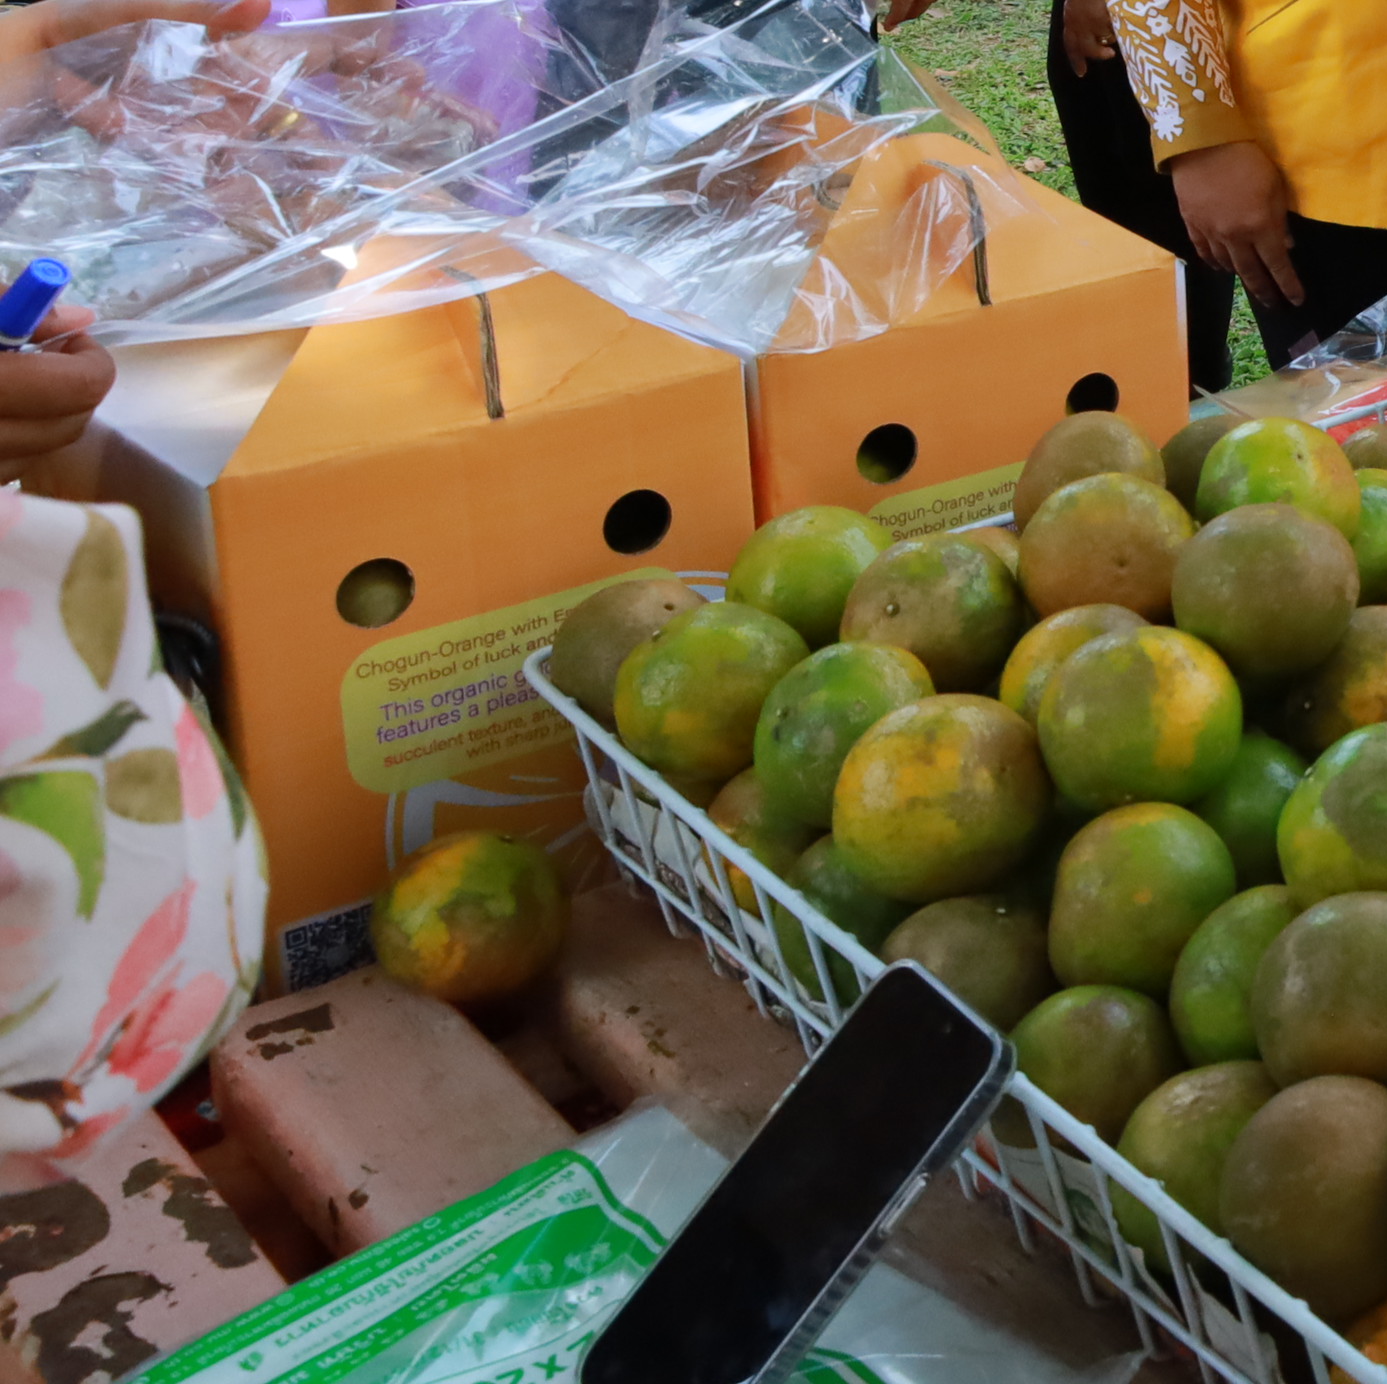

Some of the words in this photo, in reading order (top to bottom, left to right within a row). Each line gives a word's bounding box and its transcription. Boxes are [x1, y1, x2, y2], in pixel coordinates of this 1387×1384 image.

[949, 513, 964, 528] of
[965, 503, 996, 522] luck
[355, 628, 507, 680] Chogun-Orange
[511, 611, 550, 638] with
[387, 661, 458, 694] Symbol
[462, 653, 482, 673] of
[484, 640, 522, 665] luck
[375, 706, 463, 745] features
[467, 704, 481, 719] a
[487, 684, 540, 716] pleas
[379, 698, 425, 723] This
[430, 671, 509, 713] organic
[383, 732, 465, 769] succulent
[465, 738, 501, 761] with
